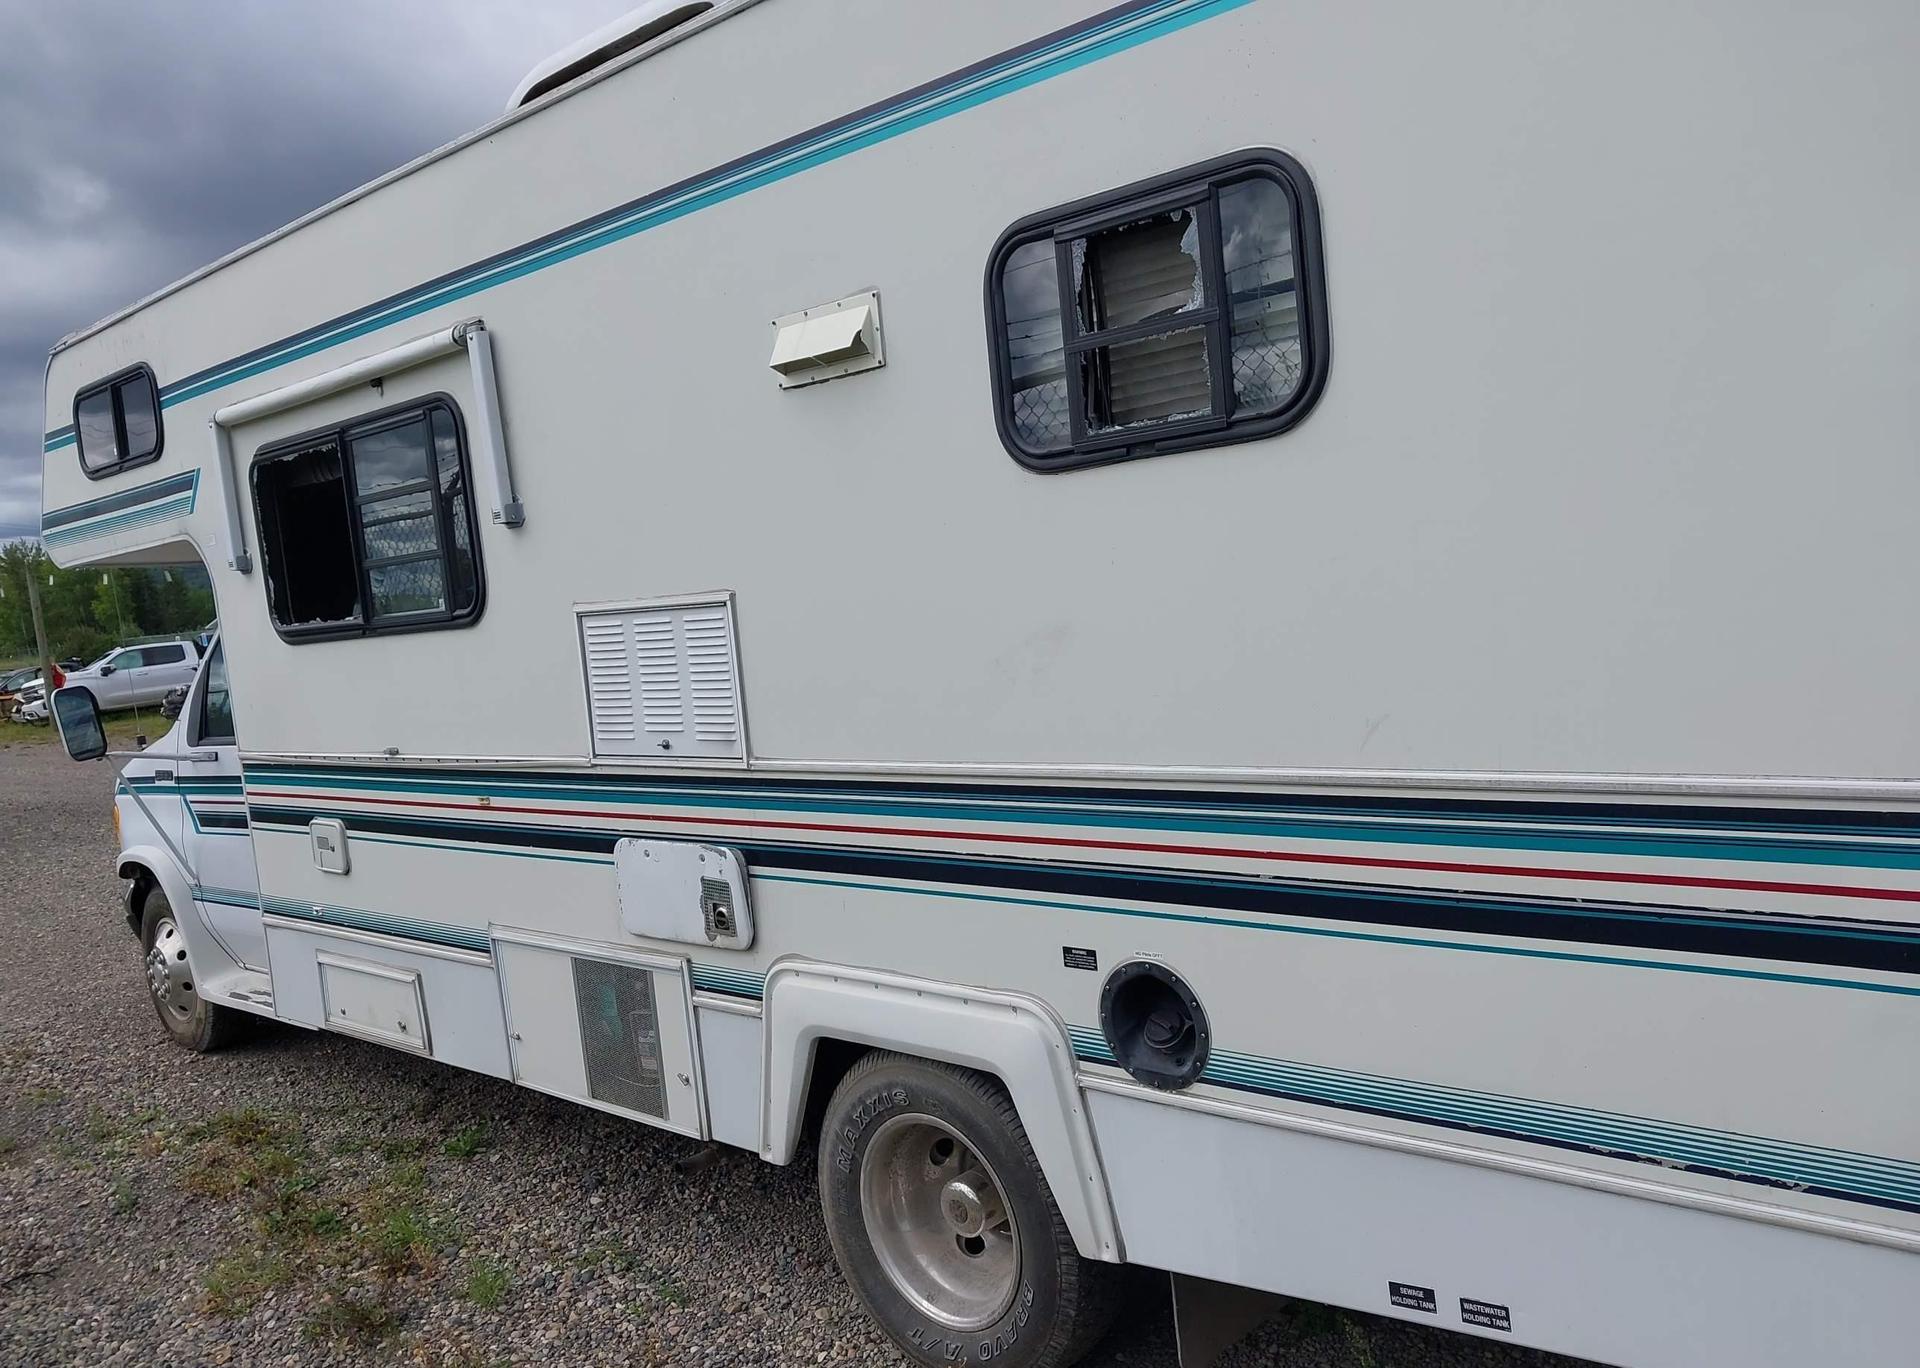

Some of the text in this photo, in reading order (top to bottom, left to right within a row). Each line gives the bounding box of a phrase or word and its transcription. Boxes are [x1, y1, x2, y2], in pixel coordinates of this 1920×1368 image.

[837, 1089, 910, 1173] MAXXIS
[1400, 1287, 1424, 1298] SEWAGE
[1391, 1295, 1435, 1310] HOLDING TANK
[1463, 1302, 1506, 1318] WASTEWATER
[905, 1279, 1035, 1361] BRAVO A/T
[1462, 1312, 1510, 1329] HOLDING TANK
